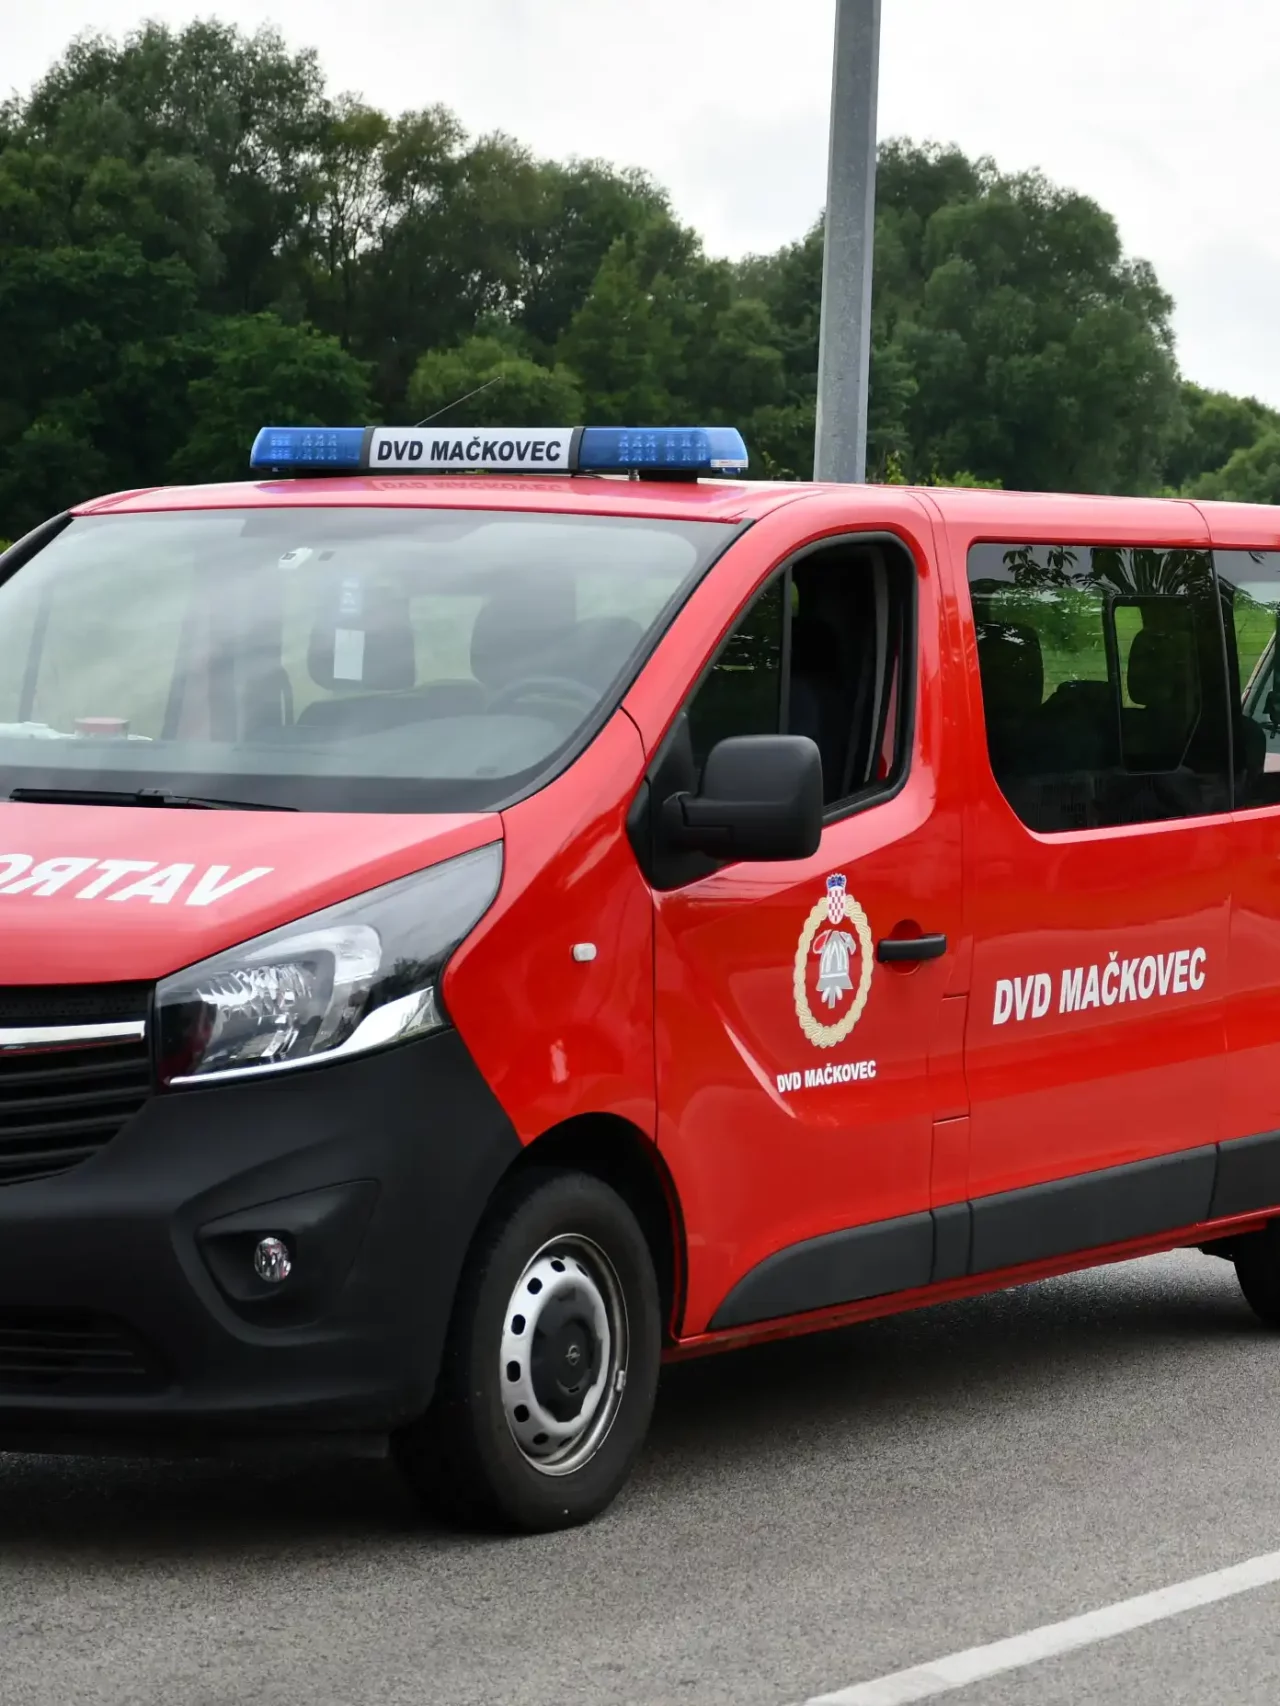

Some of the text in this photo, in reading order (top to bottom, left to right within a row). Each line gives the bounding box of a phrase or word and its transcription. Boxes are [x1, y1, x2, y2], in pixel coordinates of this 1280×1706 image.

[377, 436, 562, 461] DVD MAČKOVEC
[992, 947, 1207, 1025] DVD MAČKOVEC
[776, 1060, 877, 1093] DVD MAČKOVEC
